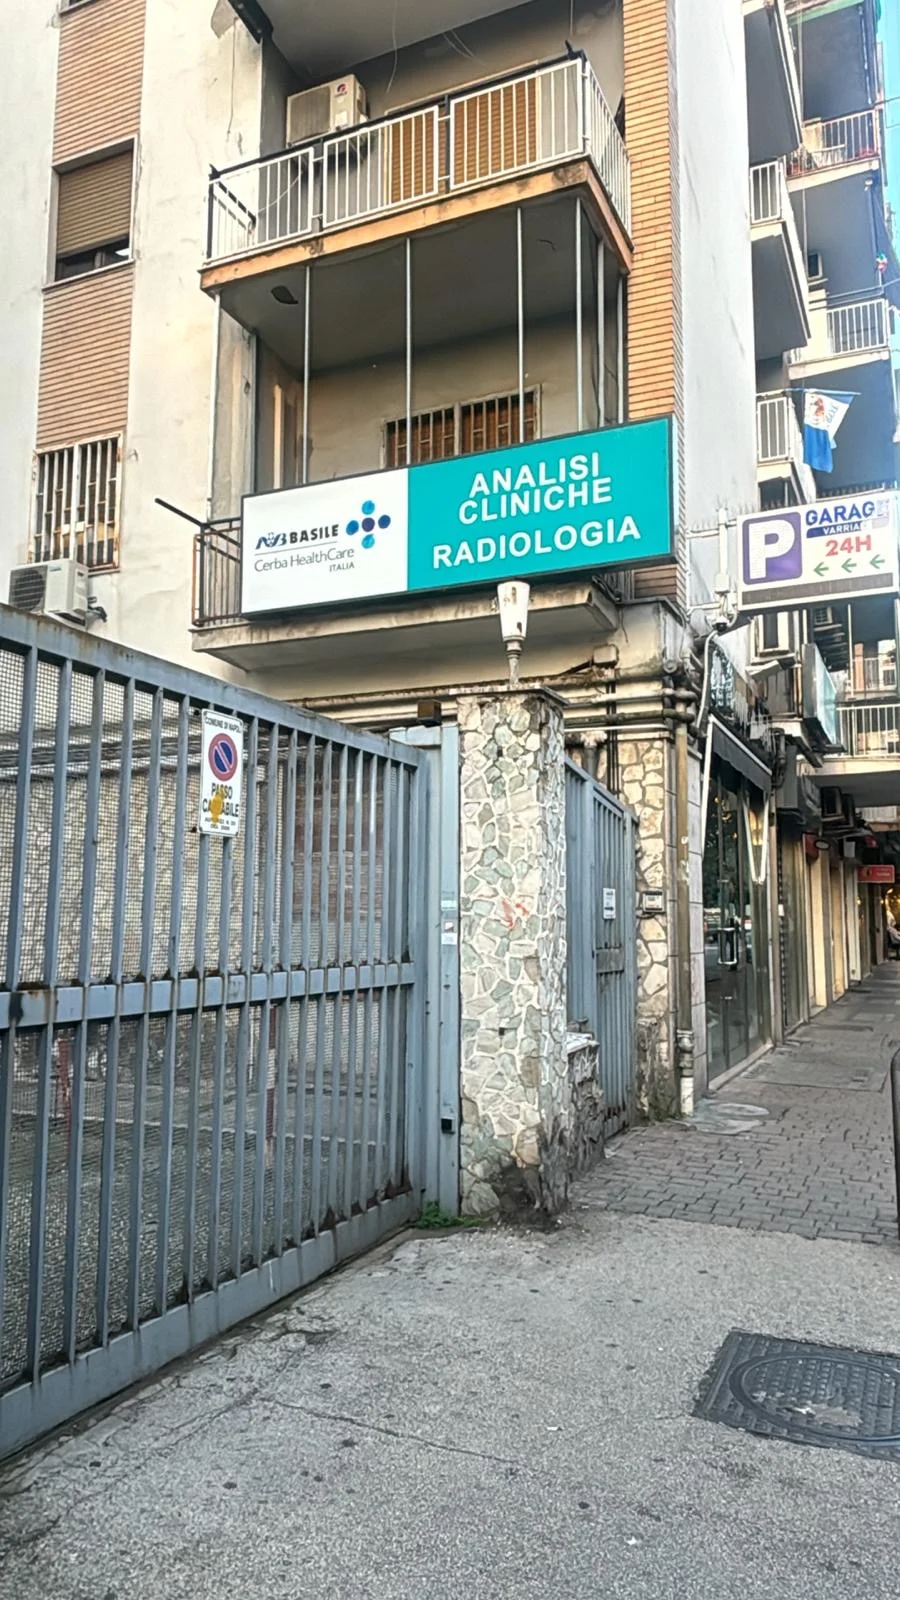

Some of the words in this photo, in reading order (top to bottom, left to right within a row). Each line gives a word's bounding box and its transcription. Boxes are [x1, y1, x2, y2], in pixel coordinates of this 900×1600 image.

[469, 452, 599, 498] ANALISI
[458, 477, 612, 524] CLINICHE
[805, 498, 889, 526] GARAG
[290, 524, 339, 544] BASILE
[433, 515, 641, 568] RADIOLOGIA
[825, 534, 872, 557] 24H
[254, 557, 288, 572] Cerba
[290, 547, 355, 567] HealthCare
[748, 519, 795, 580] P
[329, 561, 355, 573] ITALIA
